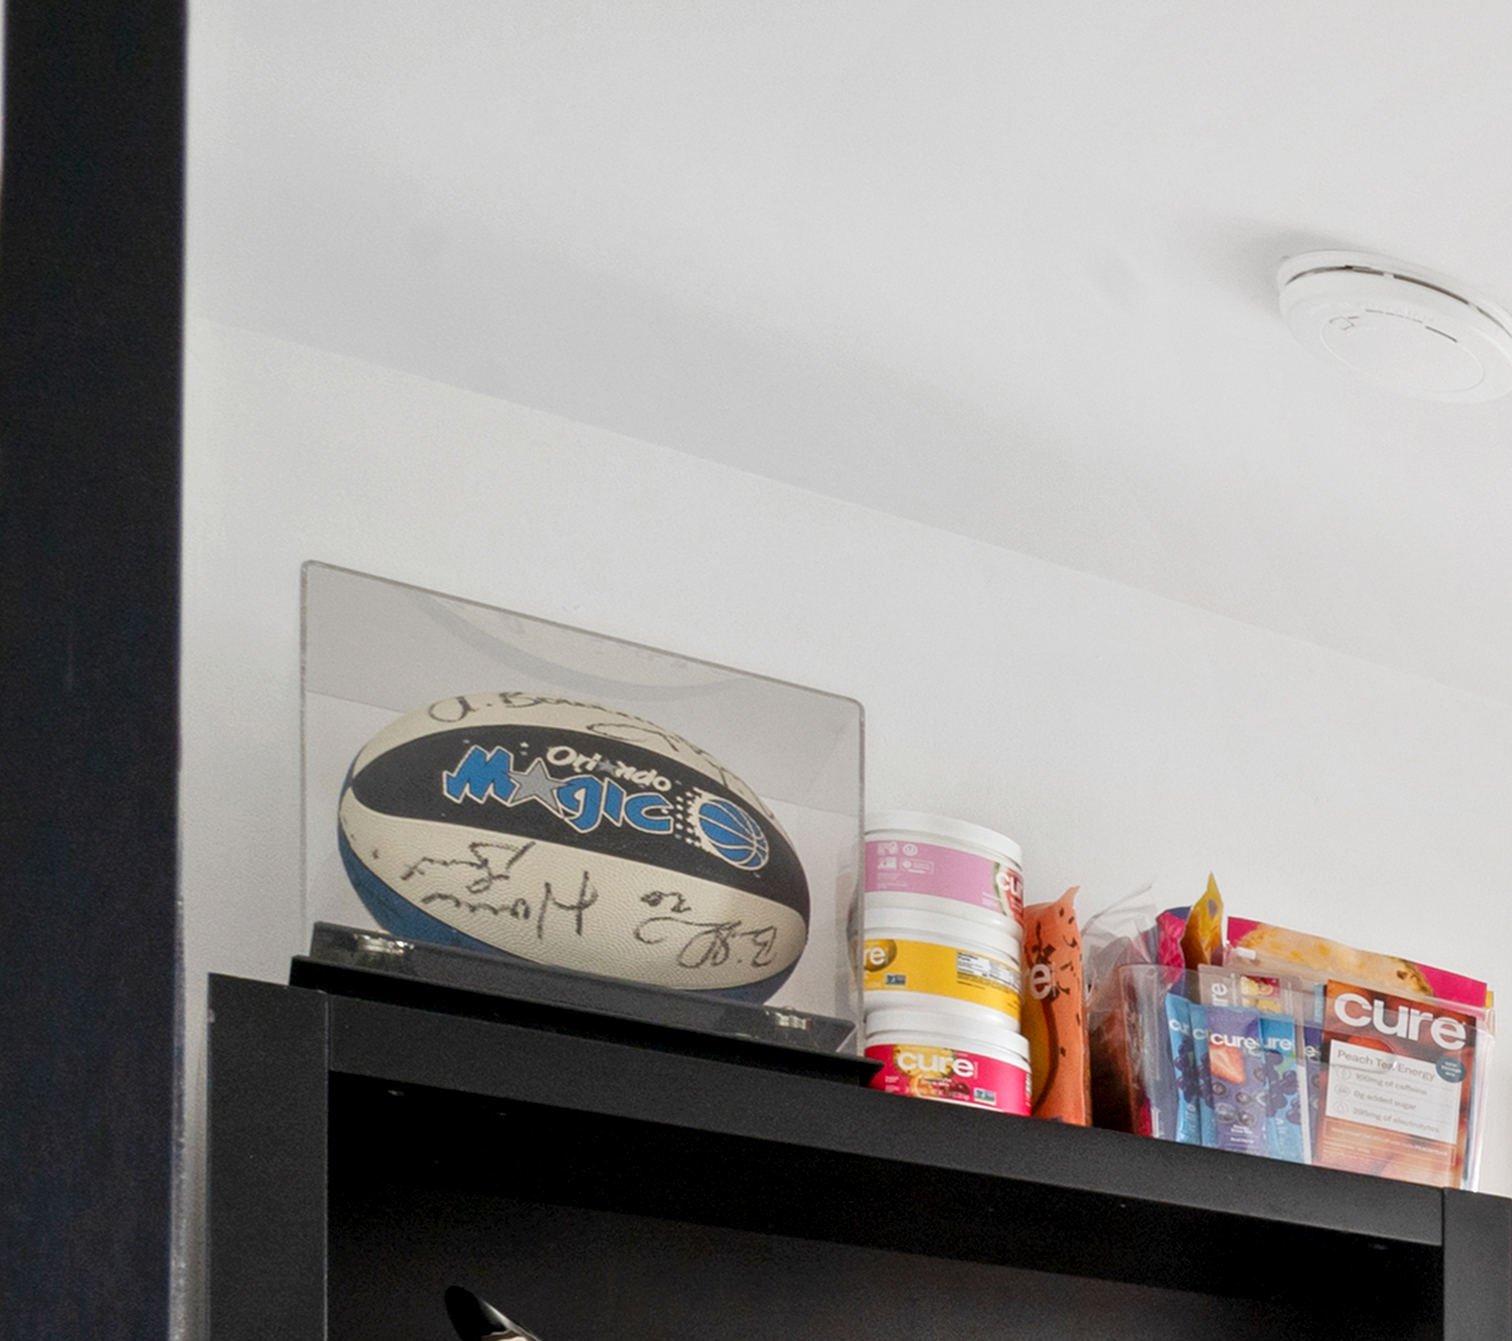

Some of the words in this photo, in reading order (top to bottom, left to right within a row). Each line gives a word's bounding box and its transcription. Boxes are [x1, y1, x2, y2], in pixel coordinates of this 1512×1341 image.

[1334, 992, 1466, 1050] cure
[897, 1051, 974, 1078] cure
[1337, 1050, 1373, 1067] Peach
[1397, 1063, 1435, 1081] Energy
